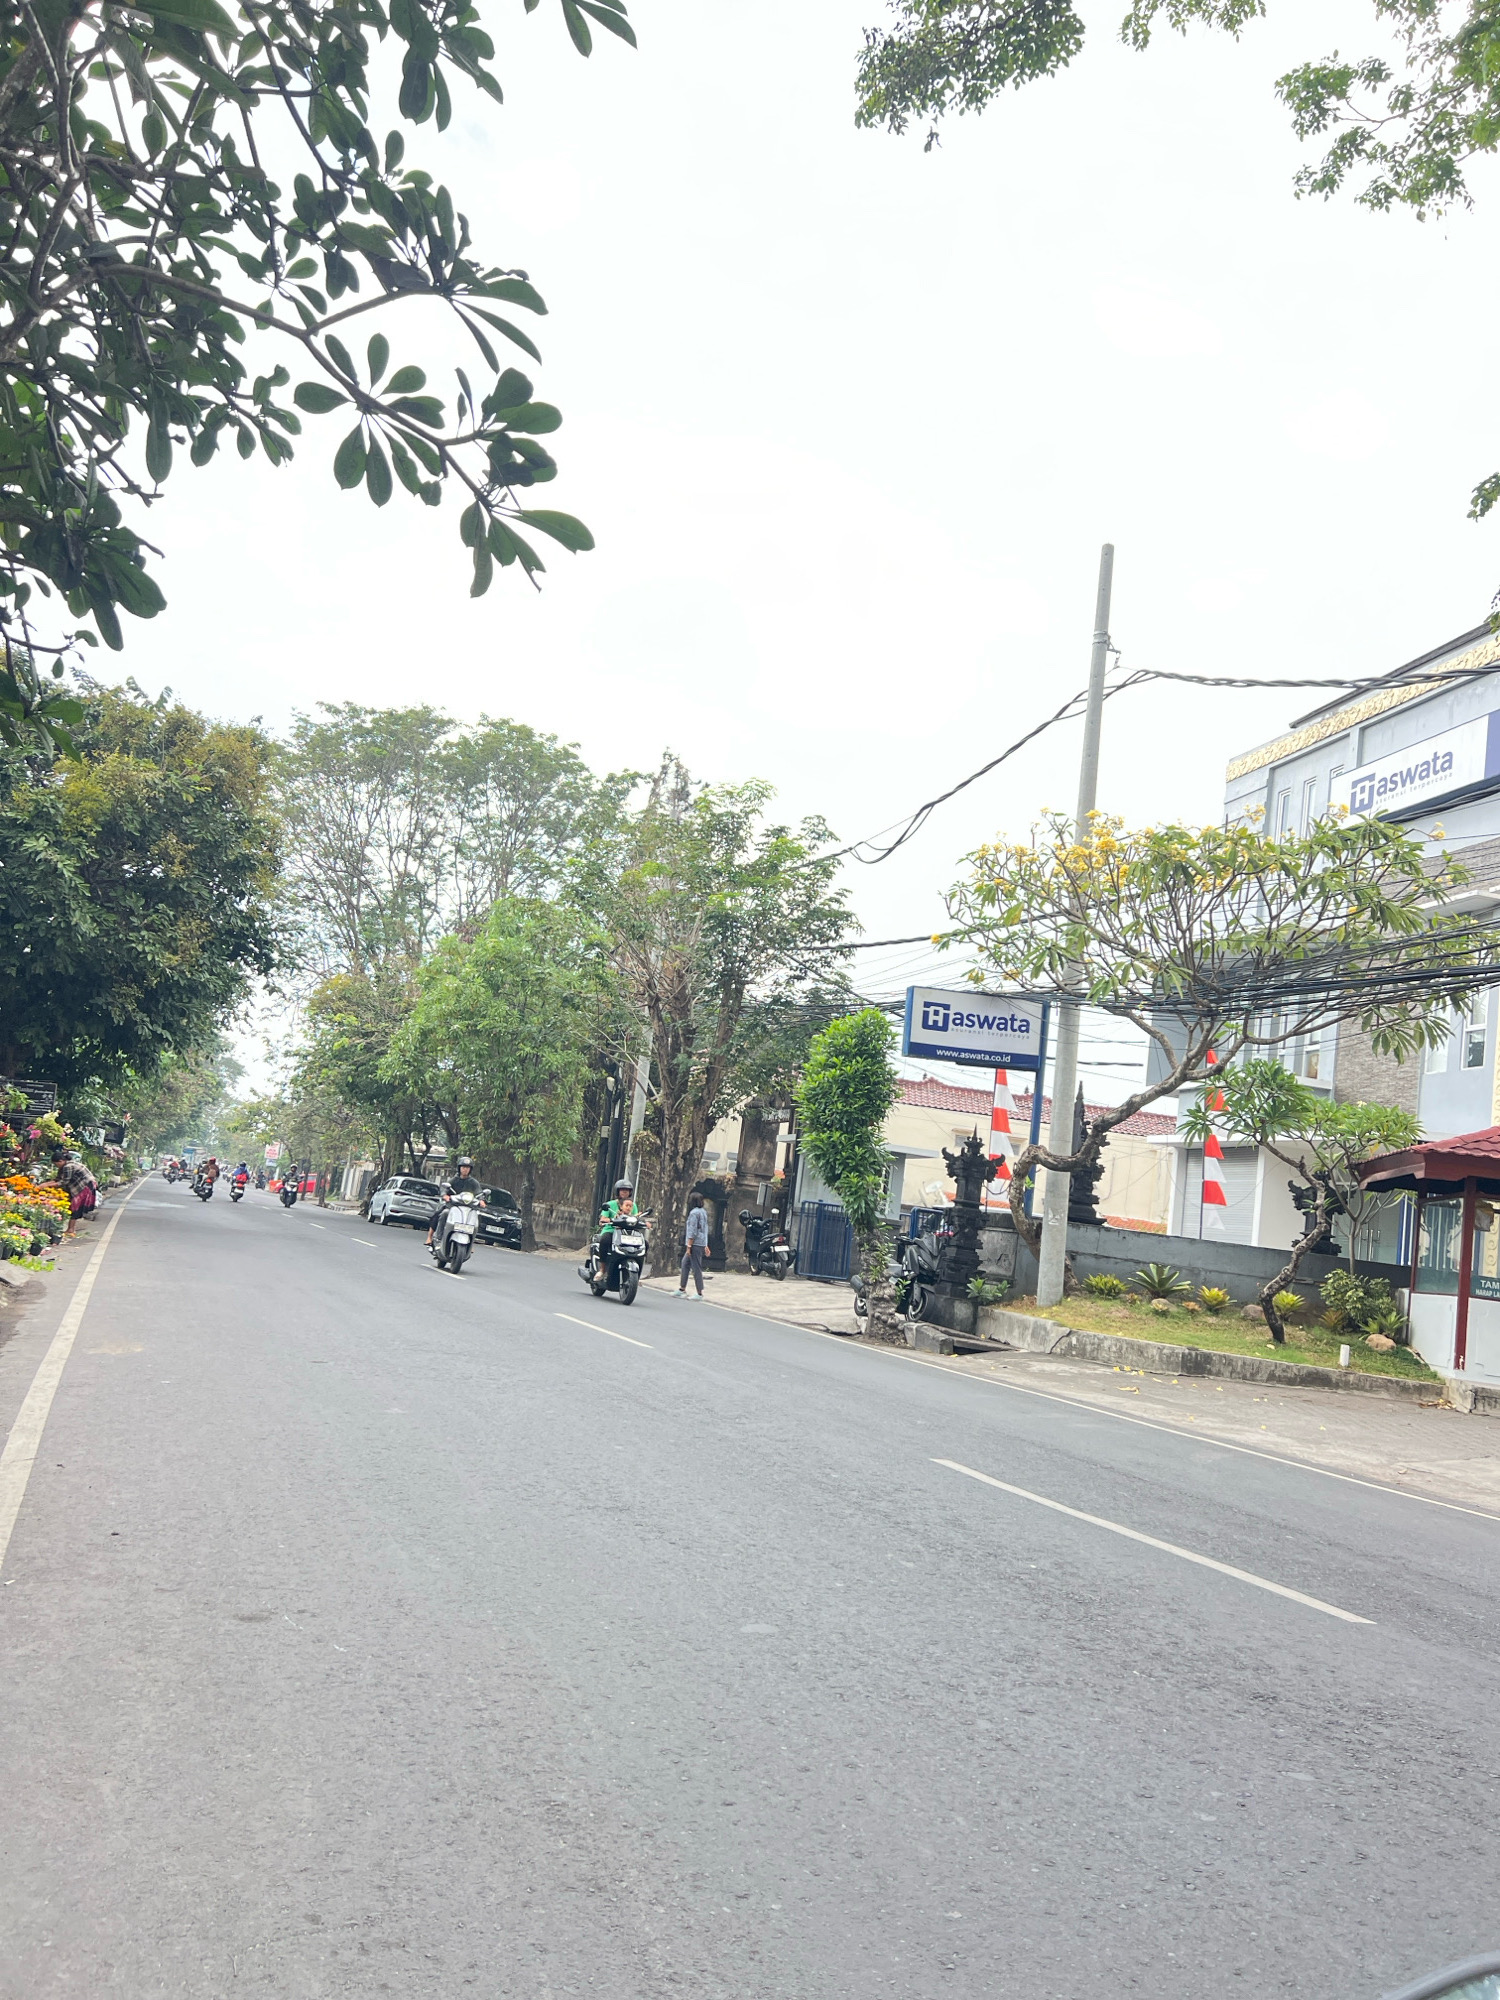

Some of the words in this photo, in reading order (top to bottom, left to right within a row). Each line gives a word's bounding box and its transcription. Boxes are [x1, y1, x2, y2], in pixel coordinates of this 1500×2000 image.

[1376, 751, 1454, 797] aswata
[952, 1011, 1030, 1034] aswata
[988, 1031, 1030, 1040] terpercaya
[936, 1048, 1011, 1062] www.aswata.co.id
